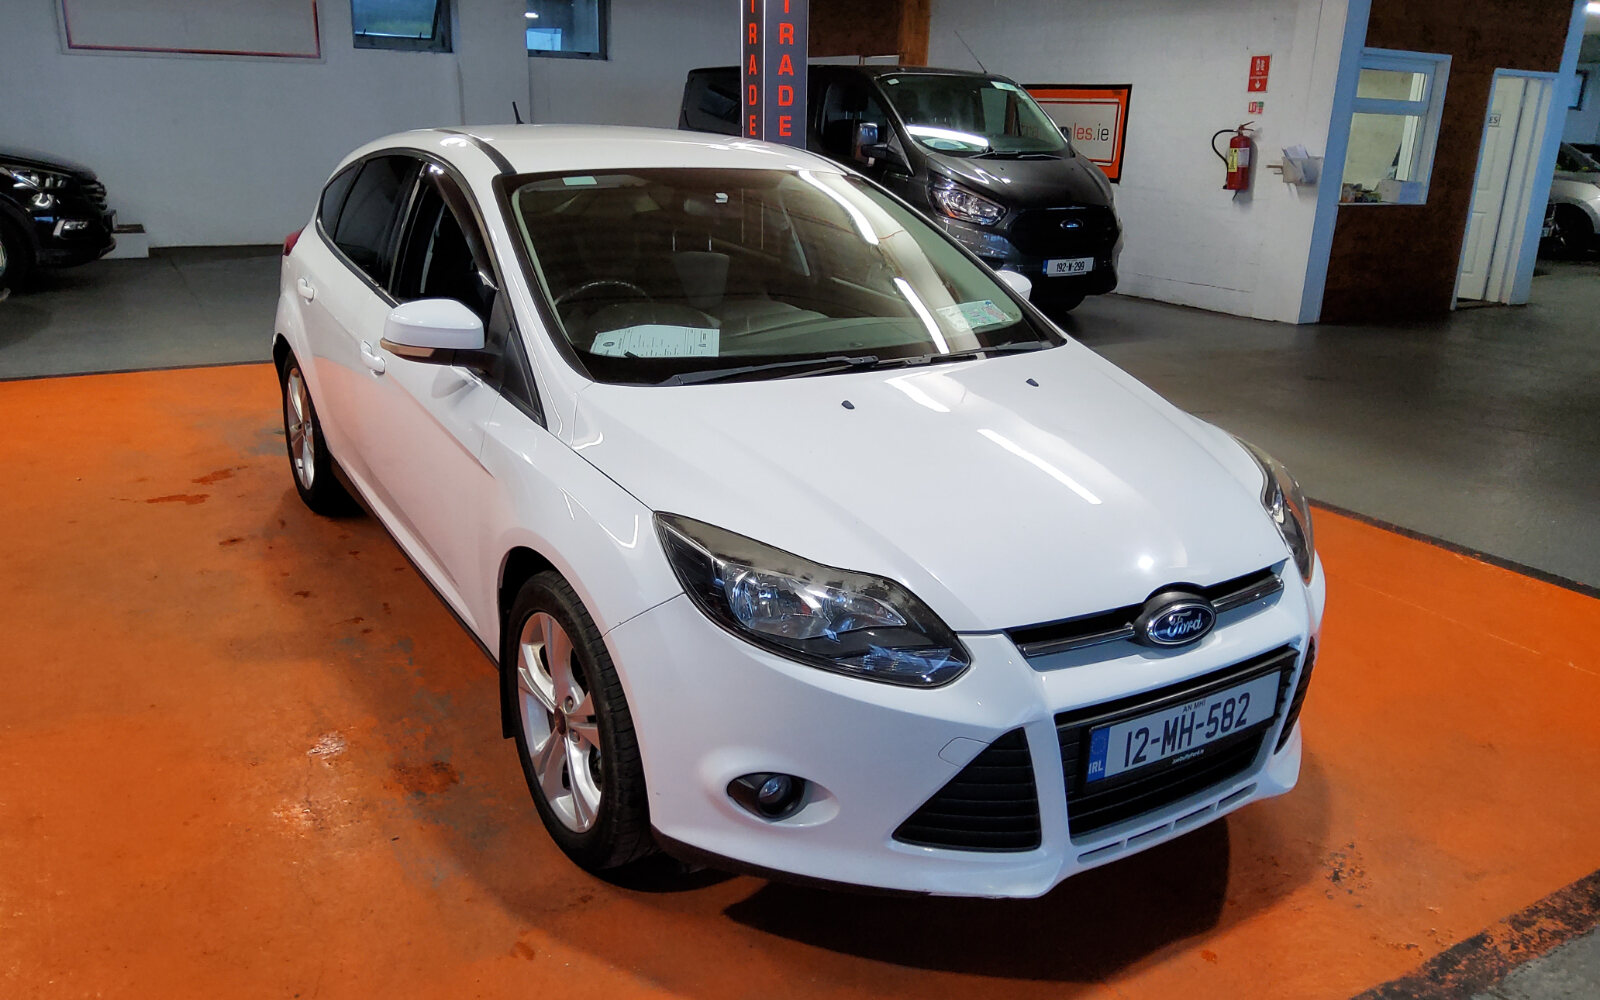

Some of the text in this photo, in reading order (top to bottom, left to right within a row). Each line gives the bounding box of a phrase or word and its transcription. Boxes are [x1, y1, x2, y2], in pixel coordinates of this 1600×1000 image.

[1167, 610, 1203, 637] Ford
[1124, 692, 1250, 768] 12-MH-582
[1088, 760, 1104, 775] IRL
